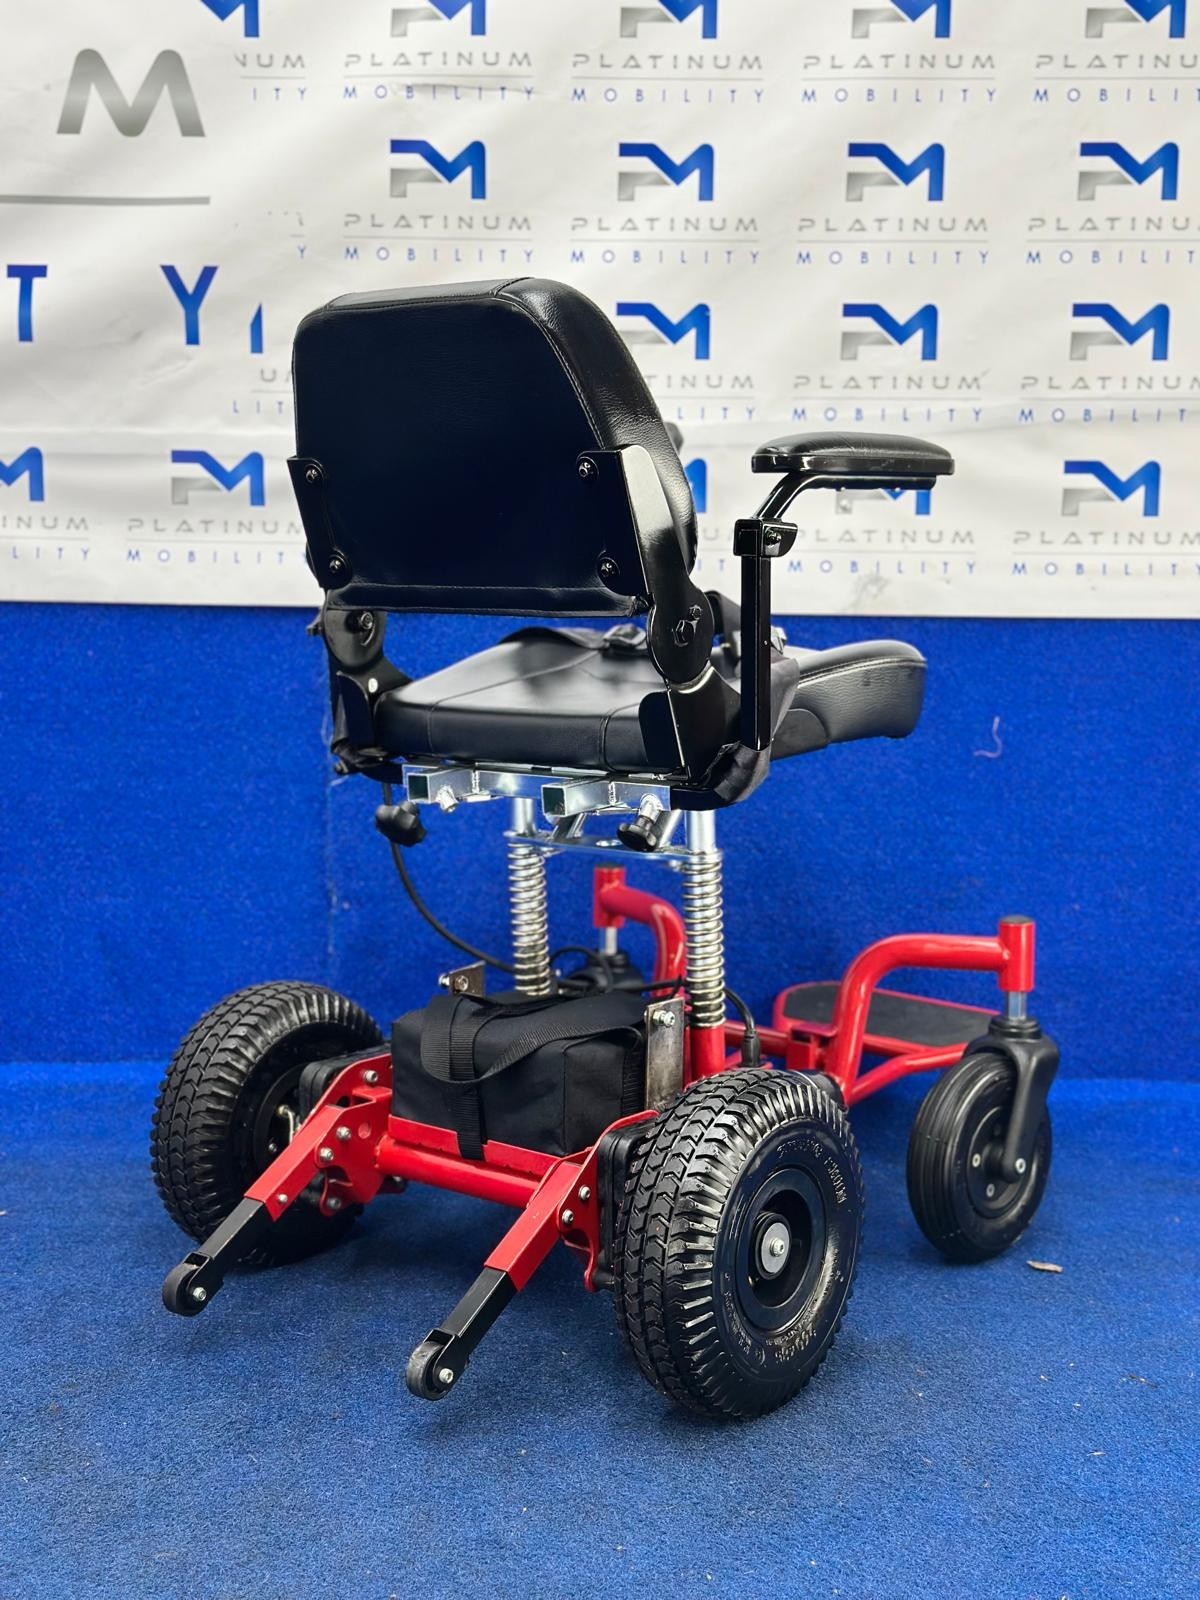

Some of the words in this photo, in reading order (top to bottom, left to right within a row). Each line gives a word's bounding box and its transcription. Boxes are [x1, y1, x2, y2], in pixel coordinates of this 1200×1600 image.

[345, 52, 531, 67] PLATINUM
[573, 54, 762, 69] PLATINUM
[804, 54, 994, 69] PLATINUM
[56, 48, 205, 138] M
[344, 87, 534, 101] MOBILITY
[572, 88, 763, 102] MOBILITY
[802, 88, 995, 102] MOBILITY
[390, 140, 486, 199] PM
[618, 142, 715, 201] PM
[847, 142, 946, 201] PM
[1078, 142, 1179, 201] PM
[344, 215, 531, 230] PLATINUM
[572, 218, 757, 232] PLATINUM
[798, 218, 987, 232] PLATINUM
[1028, 217, 1200, 231] PLATINU
[345, 247, 532, 262] MOBILITY
[571, 250, 758, 264] MOBILITY
[797, 251, 988, 265] MOBILITY
[840, 303, 938, 361] PM
[1071, 303, 1171, 361] PM
[794, 376, 980, 390] PLATINUM
[792, 407, 982, 422] MOBILITY
[171, 450, 266, 507] PM
[1061, 459, 1161, 518] PM
[787, 560, 975, 574] MOBILITY
